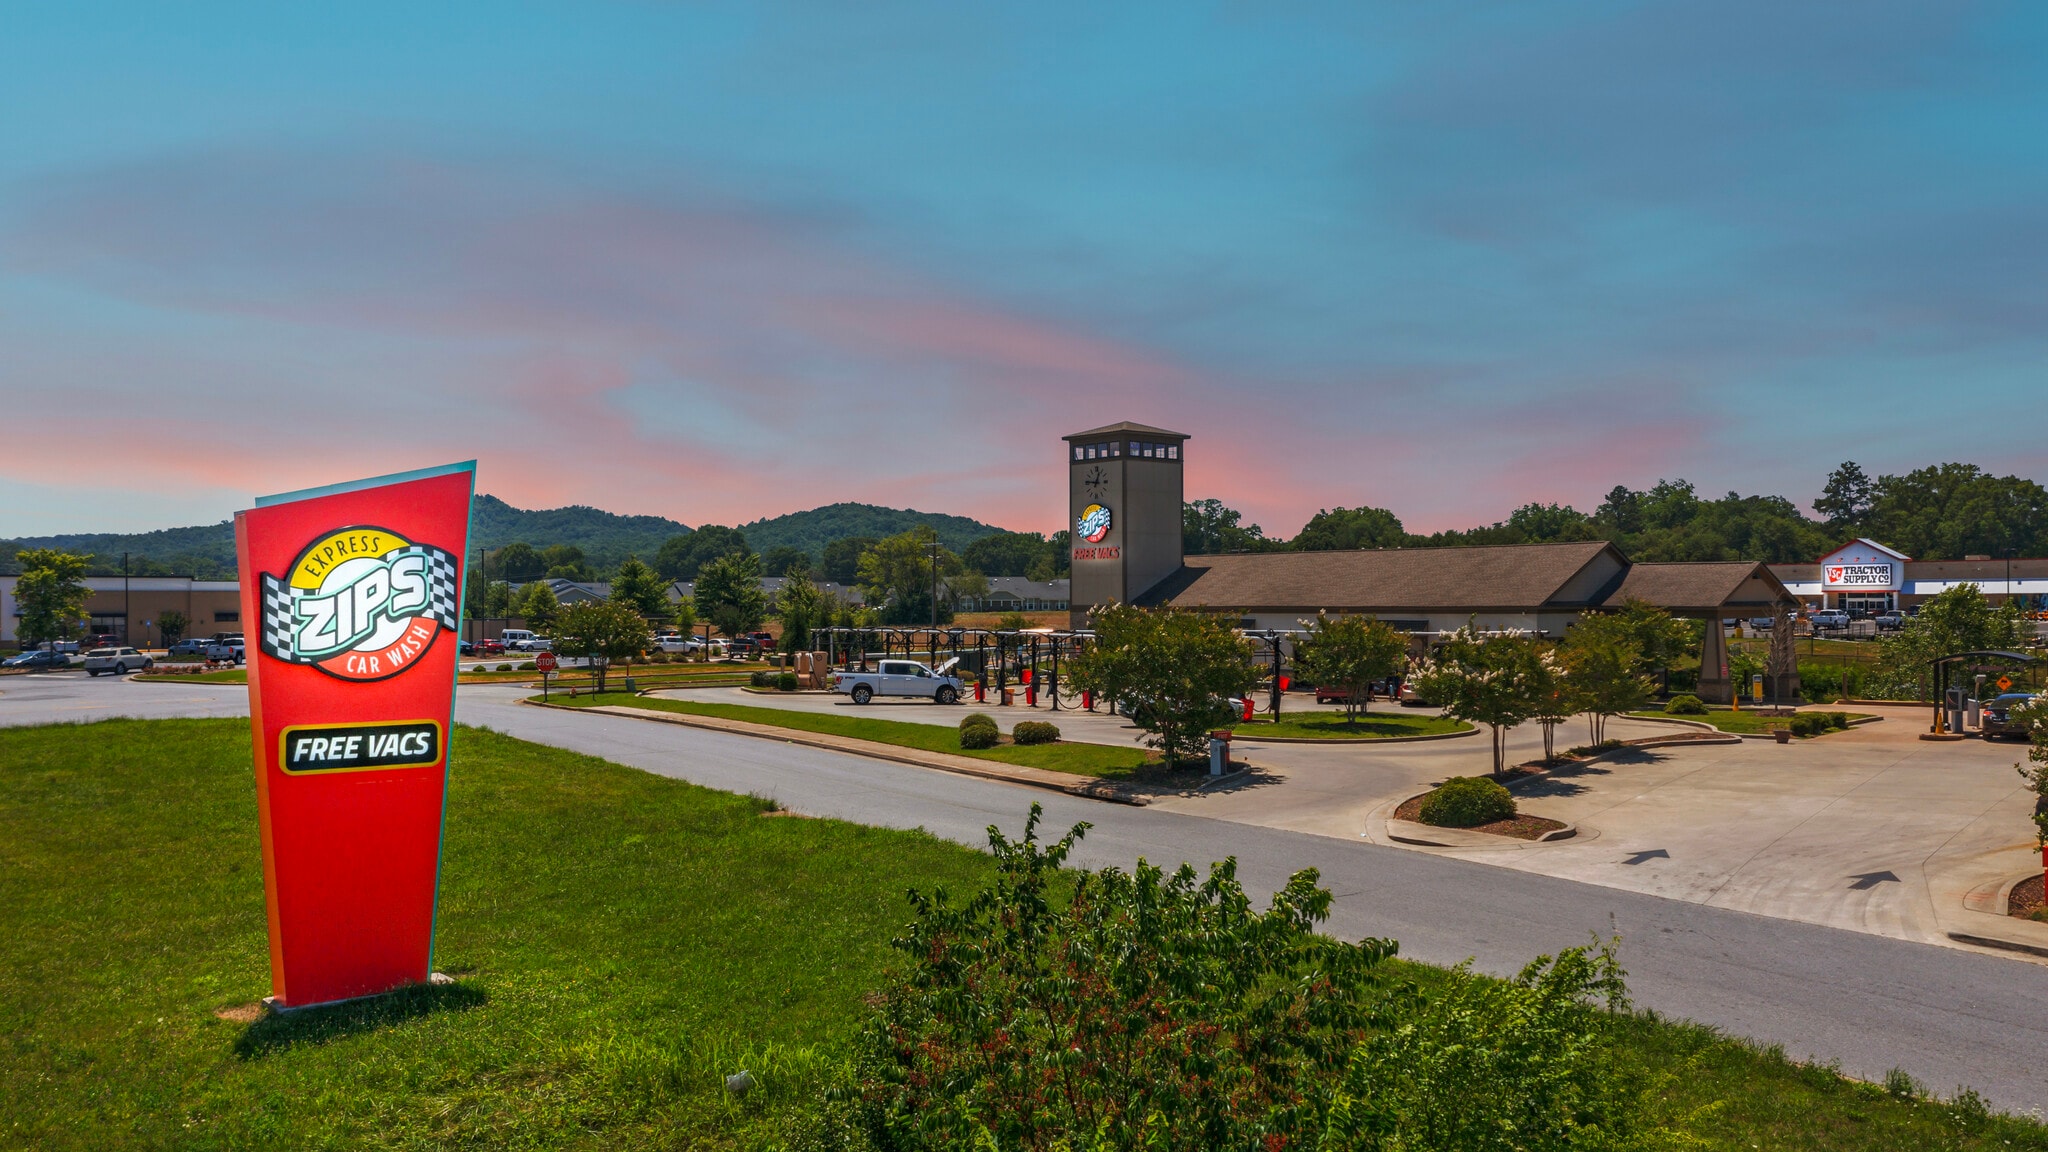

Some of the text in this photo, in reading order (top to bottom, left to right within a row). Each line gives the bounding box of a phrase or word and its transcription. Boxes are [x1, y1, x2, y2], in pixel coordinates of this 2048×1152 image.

[1083, 511, 1105, 535] ZIPS
[304, 535, 380, 578] EXPRESS
[1074, 546, 1119, 560] FREE VACS
[1827, 568, 1841, 580] TSC
[1844, 565, 1889, 574] TRACTOR
[1843, 575, 1877, 584] SUPPLY
[298, 555, 427, 652] ZIPS
[347, 625, 430, 674] CAR WASH
[537, 658, 554, 666] STOP
[293, 732, 431, 762] FREE VACS
